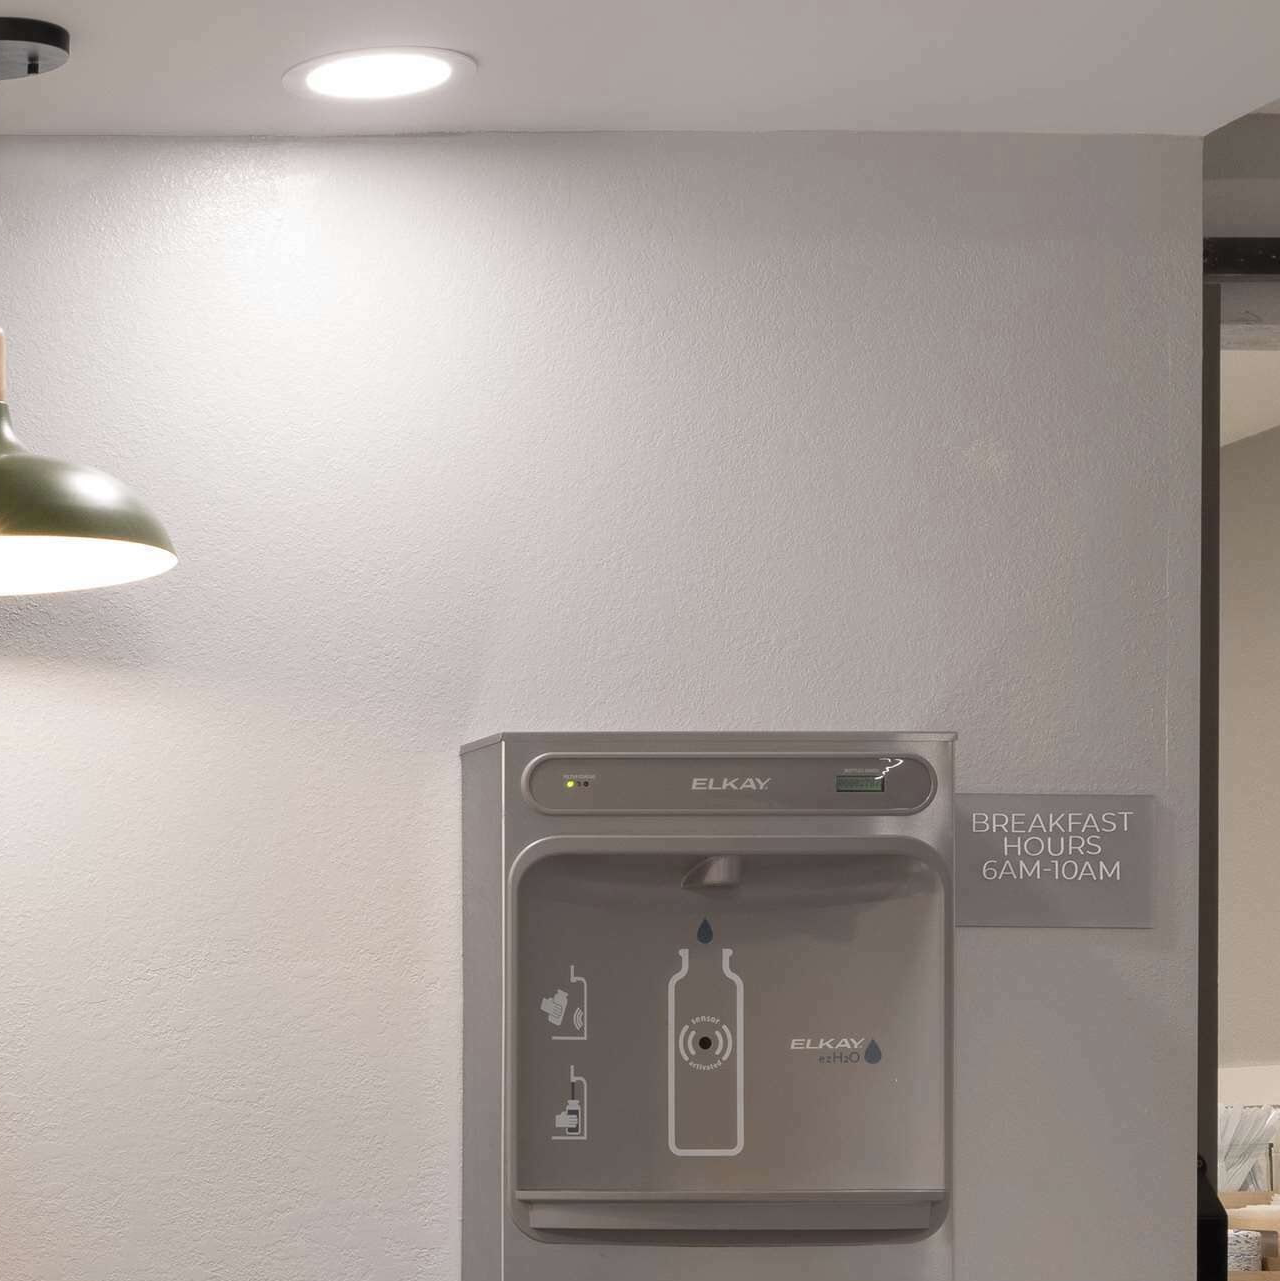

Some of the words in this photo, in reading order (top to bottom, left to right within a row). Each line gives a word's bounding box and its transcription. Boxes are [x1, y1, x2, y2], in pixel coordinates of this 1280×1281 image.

[691, 777, 771, 791] ELKAY
[972, 812, 1134, 833] BREAKFAST
[1003, 835, 1102, 857] HOURS
[982, 860, 1121, 881] 6AM-10AM
[691, 1015, 721, 1025] sensor
[791, 1038, 865, 1050] ELKAY
[688, 1060, 722, 1071] activated
